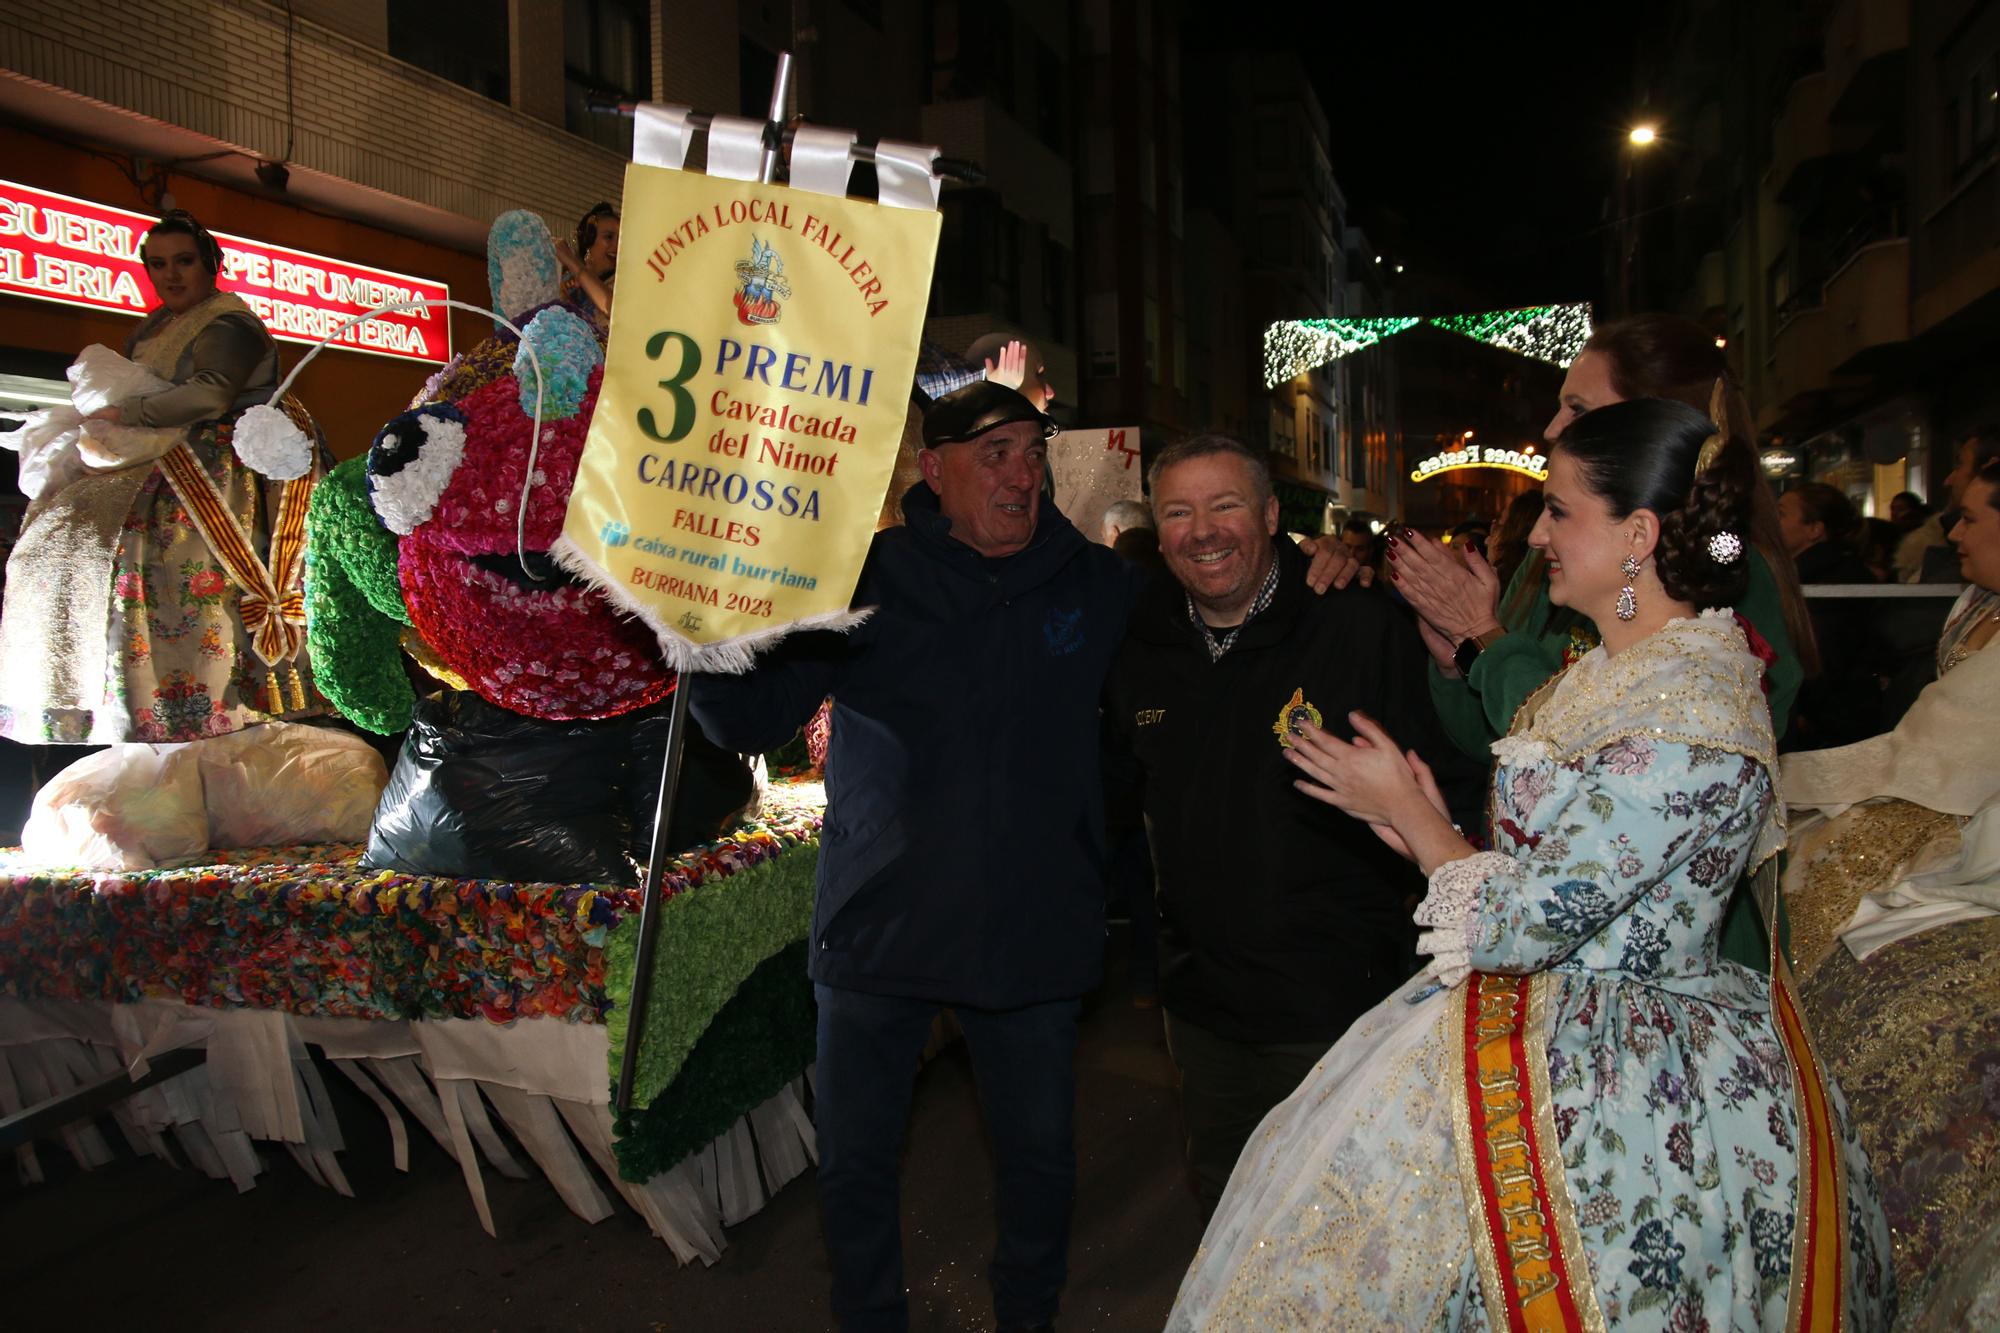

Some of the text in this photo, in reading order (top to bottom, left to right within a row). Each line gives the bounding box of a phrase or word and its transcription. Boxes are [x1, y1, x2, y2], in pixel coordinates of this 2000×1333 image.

[222, 247, 430, 319] PERFUMERIA
[646, 198, 890, 318] JUNTA LOCAL FALLERA
[233, 292, 428, 355] ERRETERIA
[637, 331, 702, 444] 3
[714, 338, 874, 406] PREMI
[710, 389, 857, 445] Cavalcada
[708, 428, 839, 477] del Ninot
[637, 453, 821, 522] CARROSSA
[672, 508, 761, 547] FALLES
[629, 566, 773, 619] BURRIANA 2023
[634, 535, 817, 591] caixa rural burriana
[1477, 1064, 1560, 1308] FALLERA
